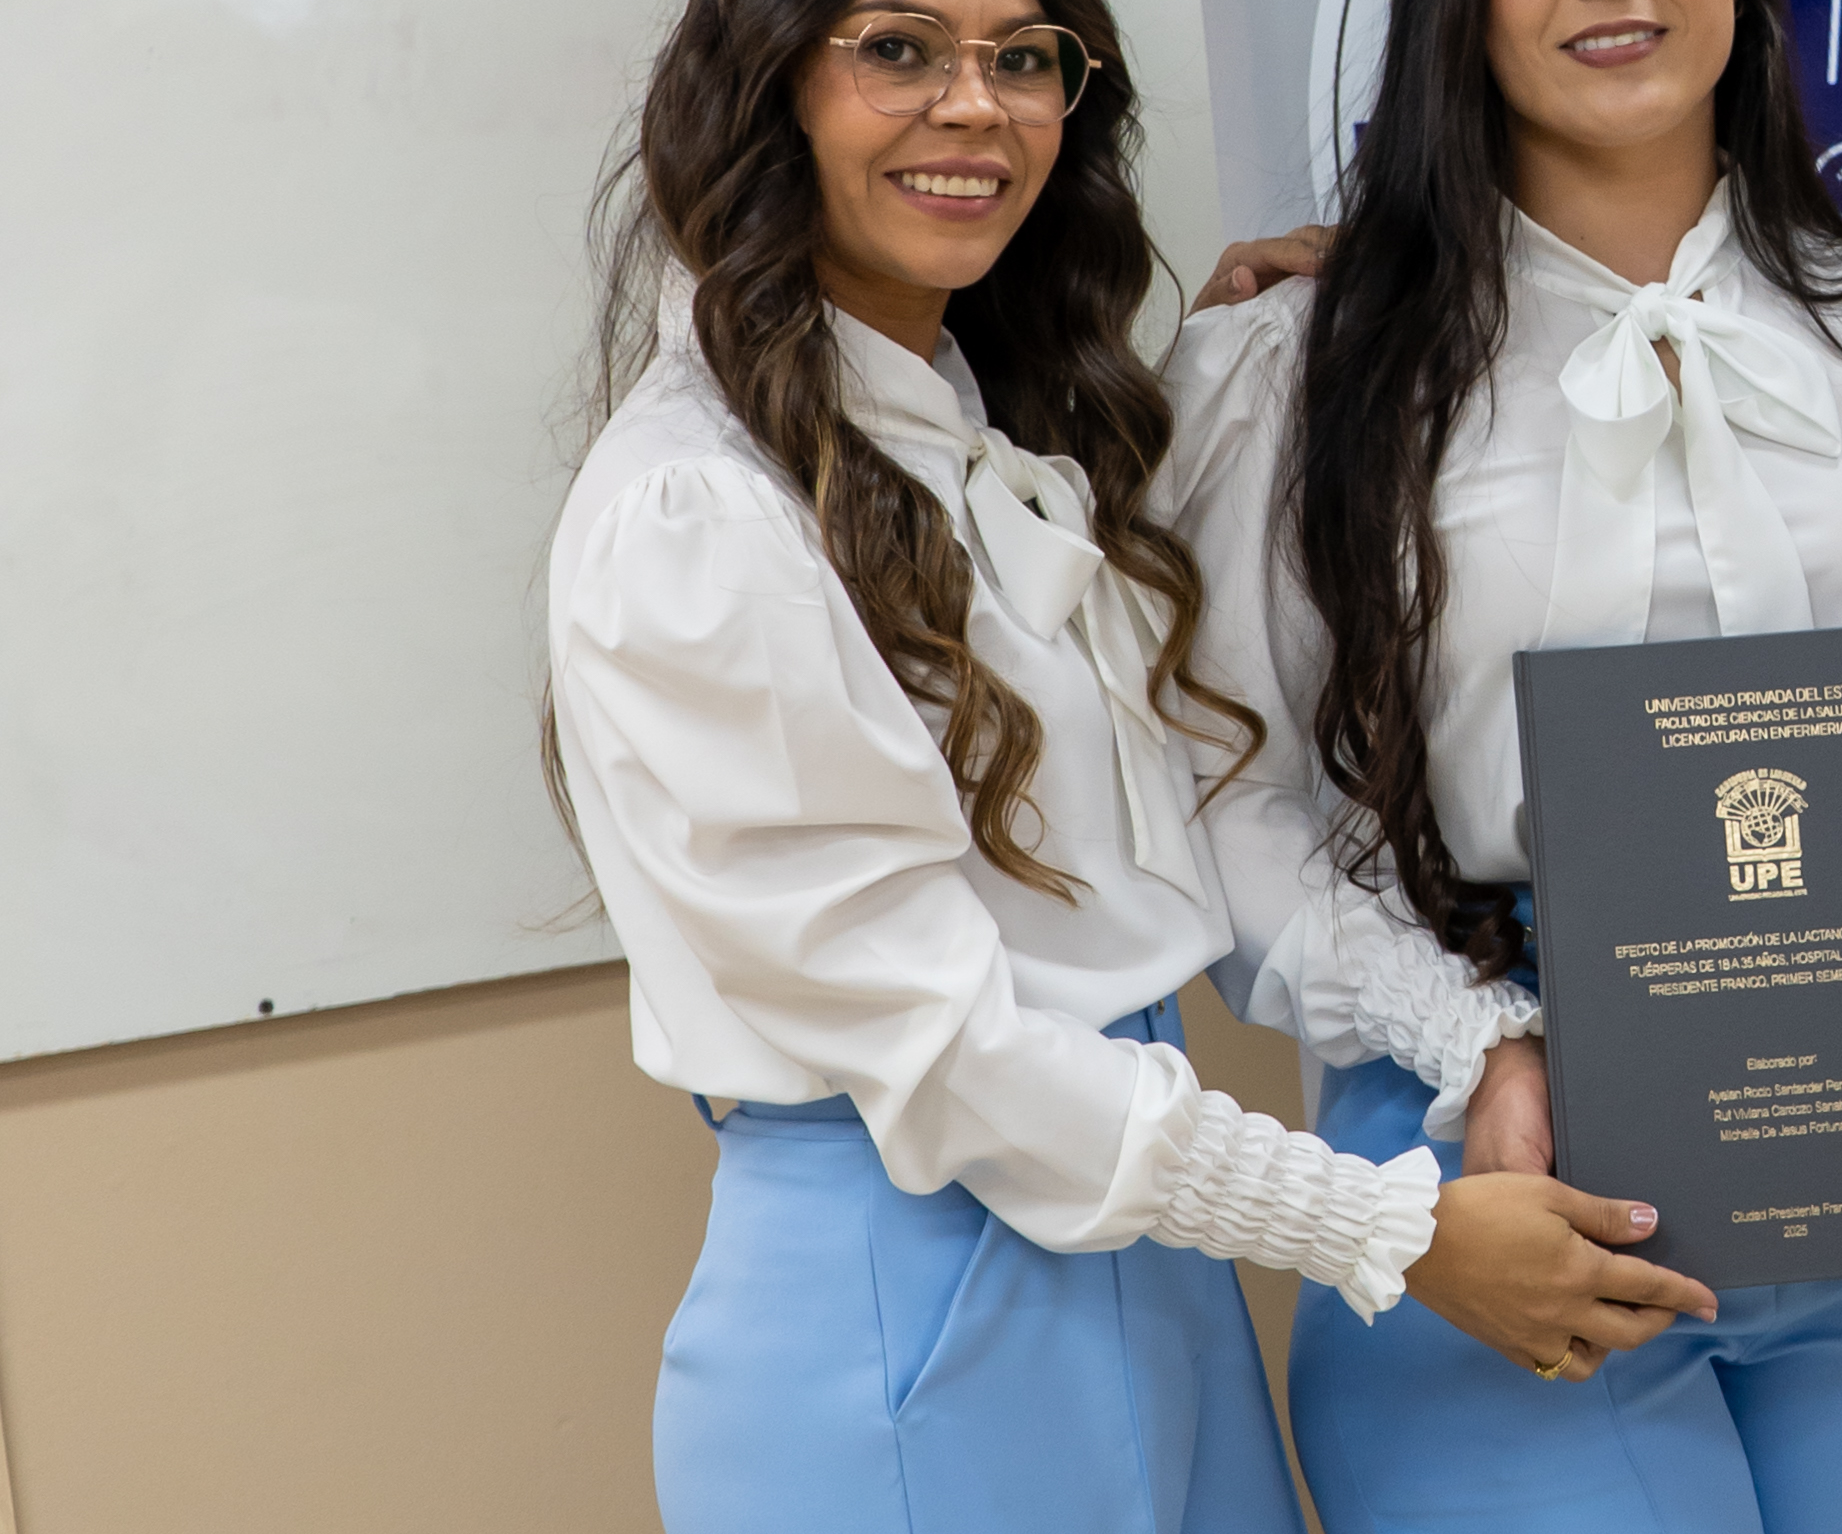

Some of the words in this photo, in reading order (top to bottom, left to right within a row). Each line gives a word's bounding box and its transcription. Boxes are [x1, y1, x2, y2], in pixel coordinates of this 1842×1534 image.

[1645, 693, 1735, 714] UNIVERSIDAD
[1737, 688, 1794, 706] PRIVADA
[1796, 686, 1821, 702] DEL
[1655, 714, 1710, 730] FACULTAD
[1712, 712, 1728, 726] DE
[1730, 709, 1781, 725] CIENCIAS
[1782, 707, 1798, 720] DE
[1801, 706, 1815, 719] LA
[1662, 729, 1749, 749] LICENCIATURA
[1750, 727, 1768, 741] EN
[1729, 860, 1804, 892] UPE
[1615, 943, 1660, 959] EFECTO
[1662, 941, 1677, 955] DE
[1680, 940, 1694, 953] LA
[1695, 931, 1763, 951] PROMOCIÓN
[1765, 932, 1780, 946] DE
[1782, 931, 1798, 945] LA
[1630, 961, 1697, 979] PUÉRPERAS
[1699, 959, 1715, 973] DE
[1718, 958, 1730, 971] 18
[1730, 957, 1740, 969] A
[1741, 956, 1753, 969] 35
[1791, 949, 1842, 965] HOSPITAL
[1649, 979, 1719, 997] PRESIDENTE
[1771, 971, 1814, 987] PRIMER
[1747, 1055, 1797, 1071] Elaborado
[1774, 1082, 1824, 1096] Santander
[1733, 1107, 1769, 1120] Viviana
[1720, 1127, 1760, 1142] Michelle
[1731, 1209, 1767, 1224] Ciudad
[1768, 1204, 1821, 1219] Presidente
[1783, 1224, 1809, 1238] 2025
